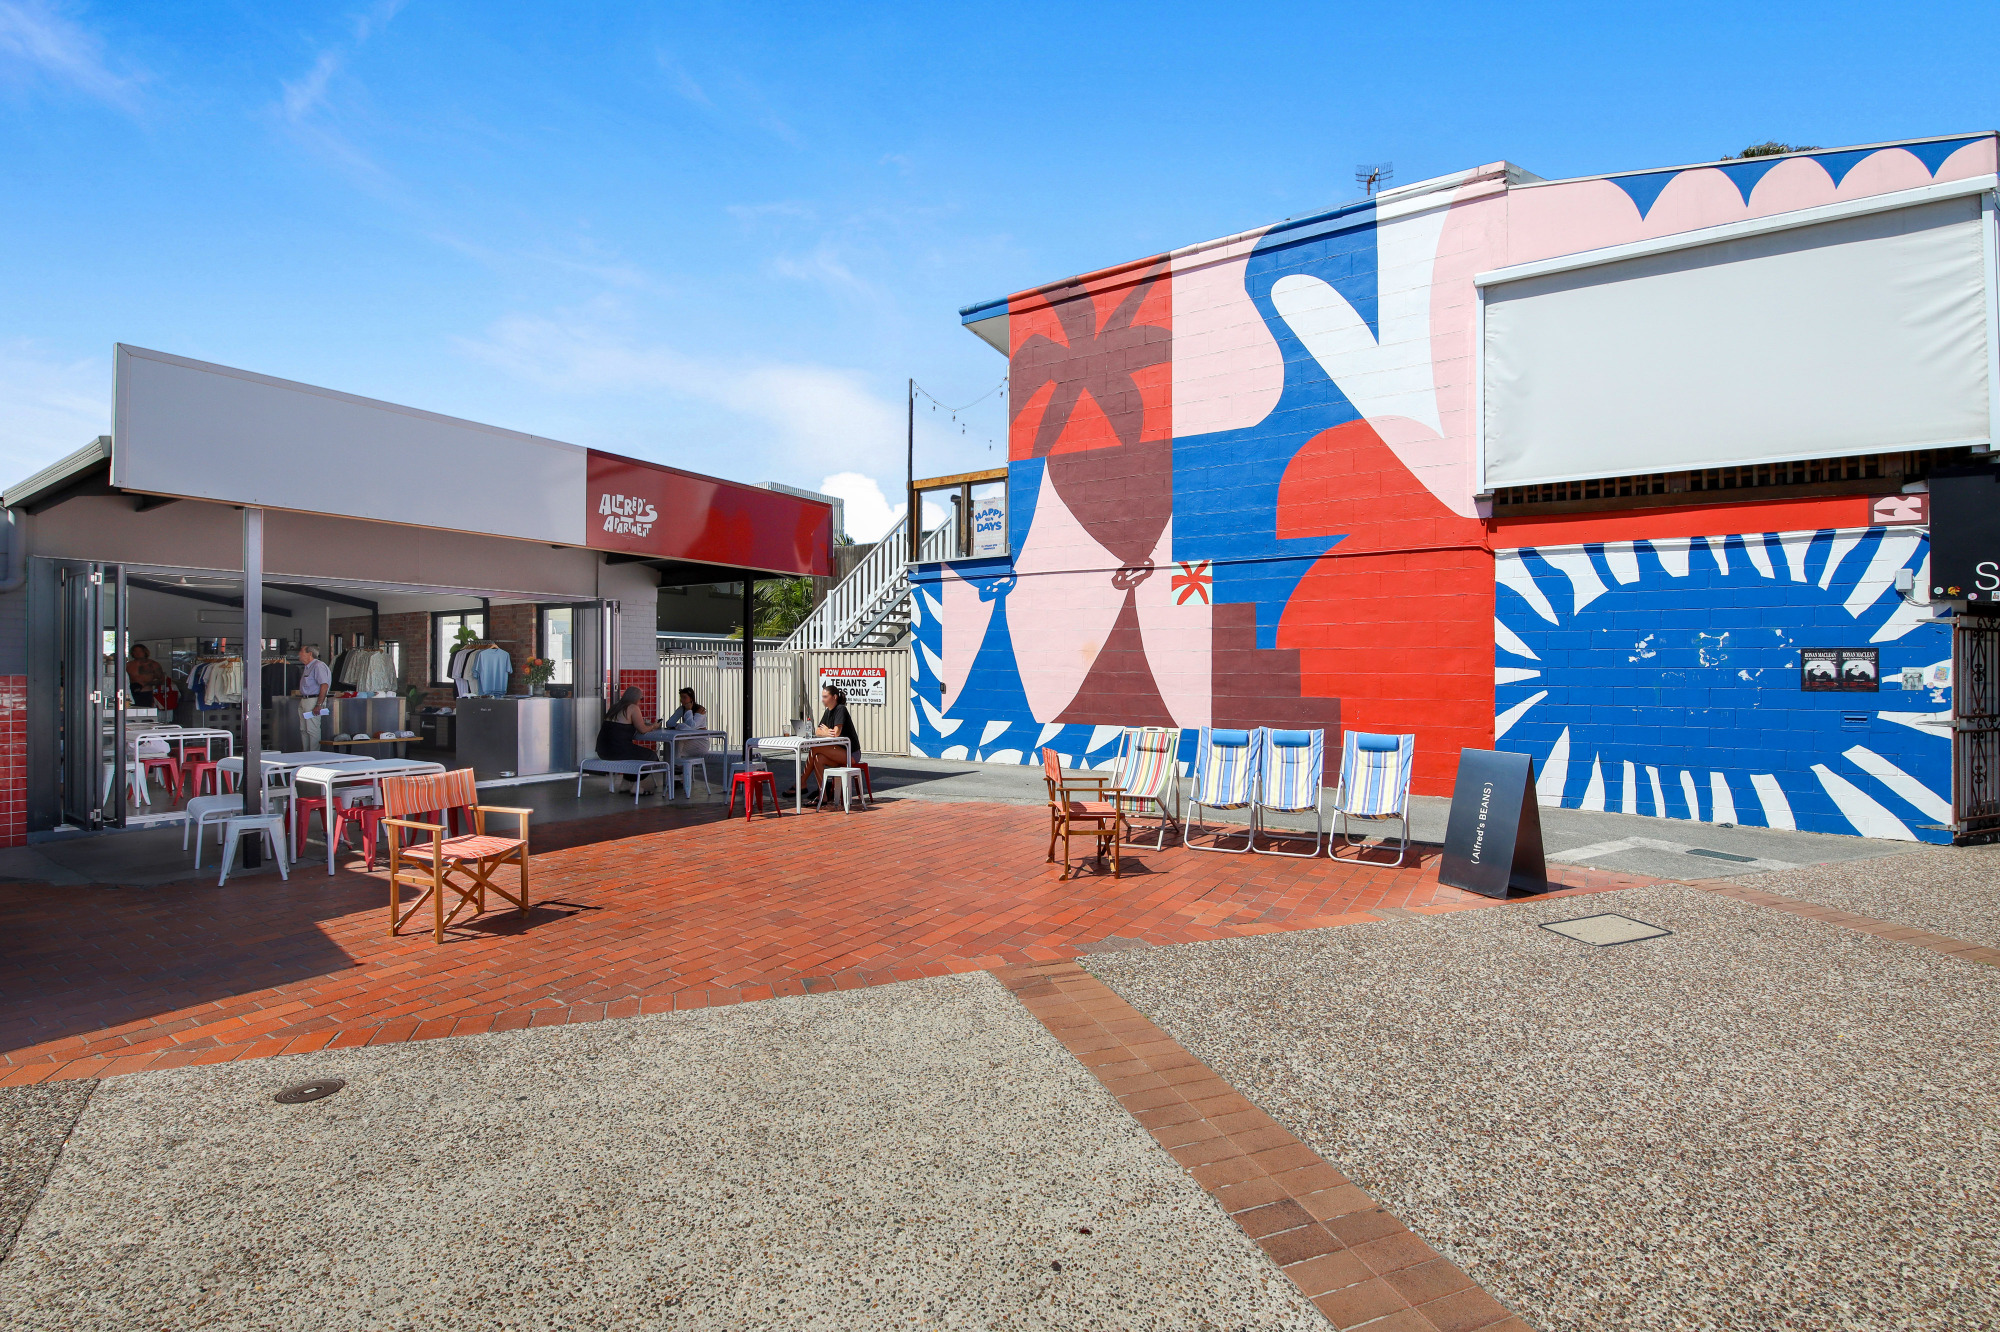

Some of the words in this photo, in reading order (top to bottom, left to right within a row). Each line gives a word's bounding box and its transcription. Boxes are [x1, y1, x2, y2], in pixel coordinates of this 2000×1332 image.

[599, 494, 658, 523] ALFRED'S
[975, 508, 1005, 521] HAPPY
[603, 515, 653, 538] APARTMENT
[976, 521, 1002, 532] DAYS
[830, 679, 867, 687] TENANTS
[850, 688, 870, 696] ONLY
